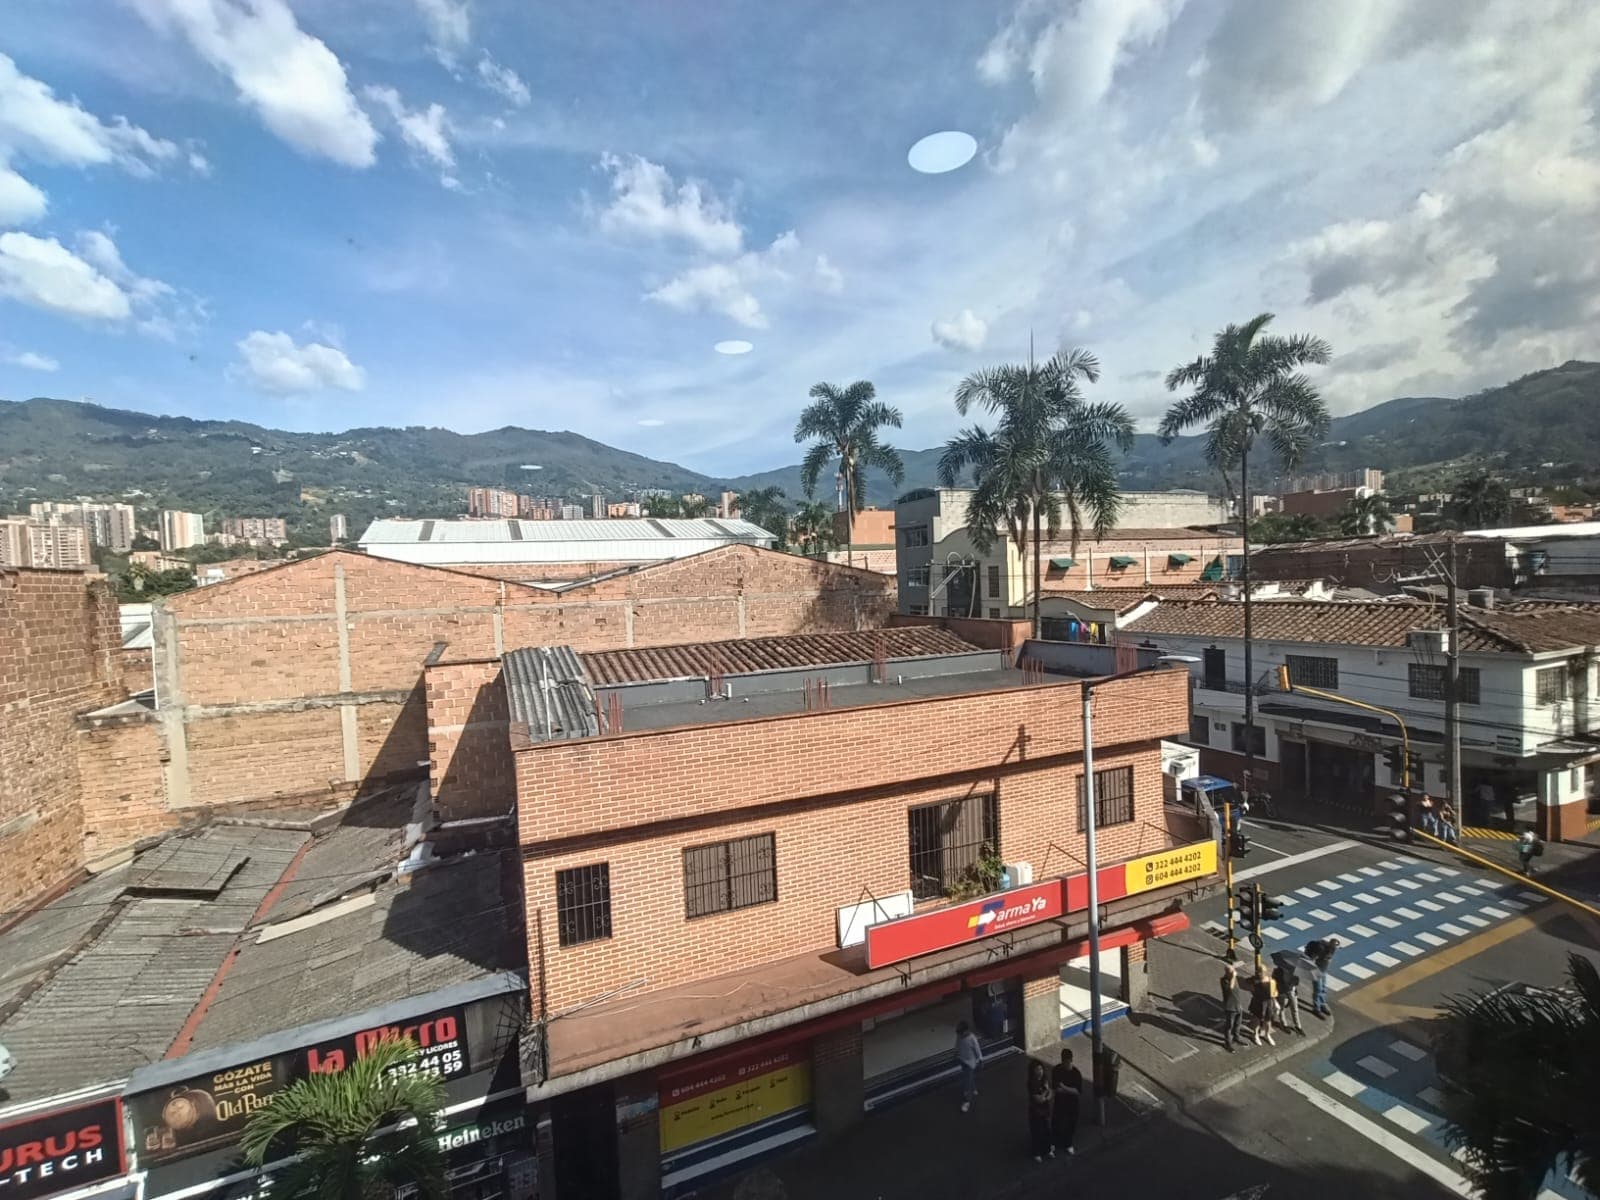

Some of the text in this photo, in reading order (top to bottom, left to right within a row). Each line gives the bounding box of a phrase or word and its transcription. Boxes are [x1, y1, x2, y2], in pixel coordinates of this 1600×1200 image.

[1155, 851, 1201, 870] 322 444 4202
[1155, 863, 1201, 881] 604 444 4202
[426, 1040, 458, 1055] LICORES
[307, 1048, 345, 1074] La
[420, 1056, 440, 1068] 44
[442, 1050, 461, 1062] 05
[444, 1060, 463, 1074] 59
[236, 1078, 249, 1086] LA
[250, 1072, 273, 1083] VIDA
[234, 1084, 254, 1094] CON
[215, 1099, 243, 1121] Old
[437, 1115, 526, 1154] Heineken
